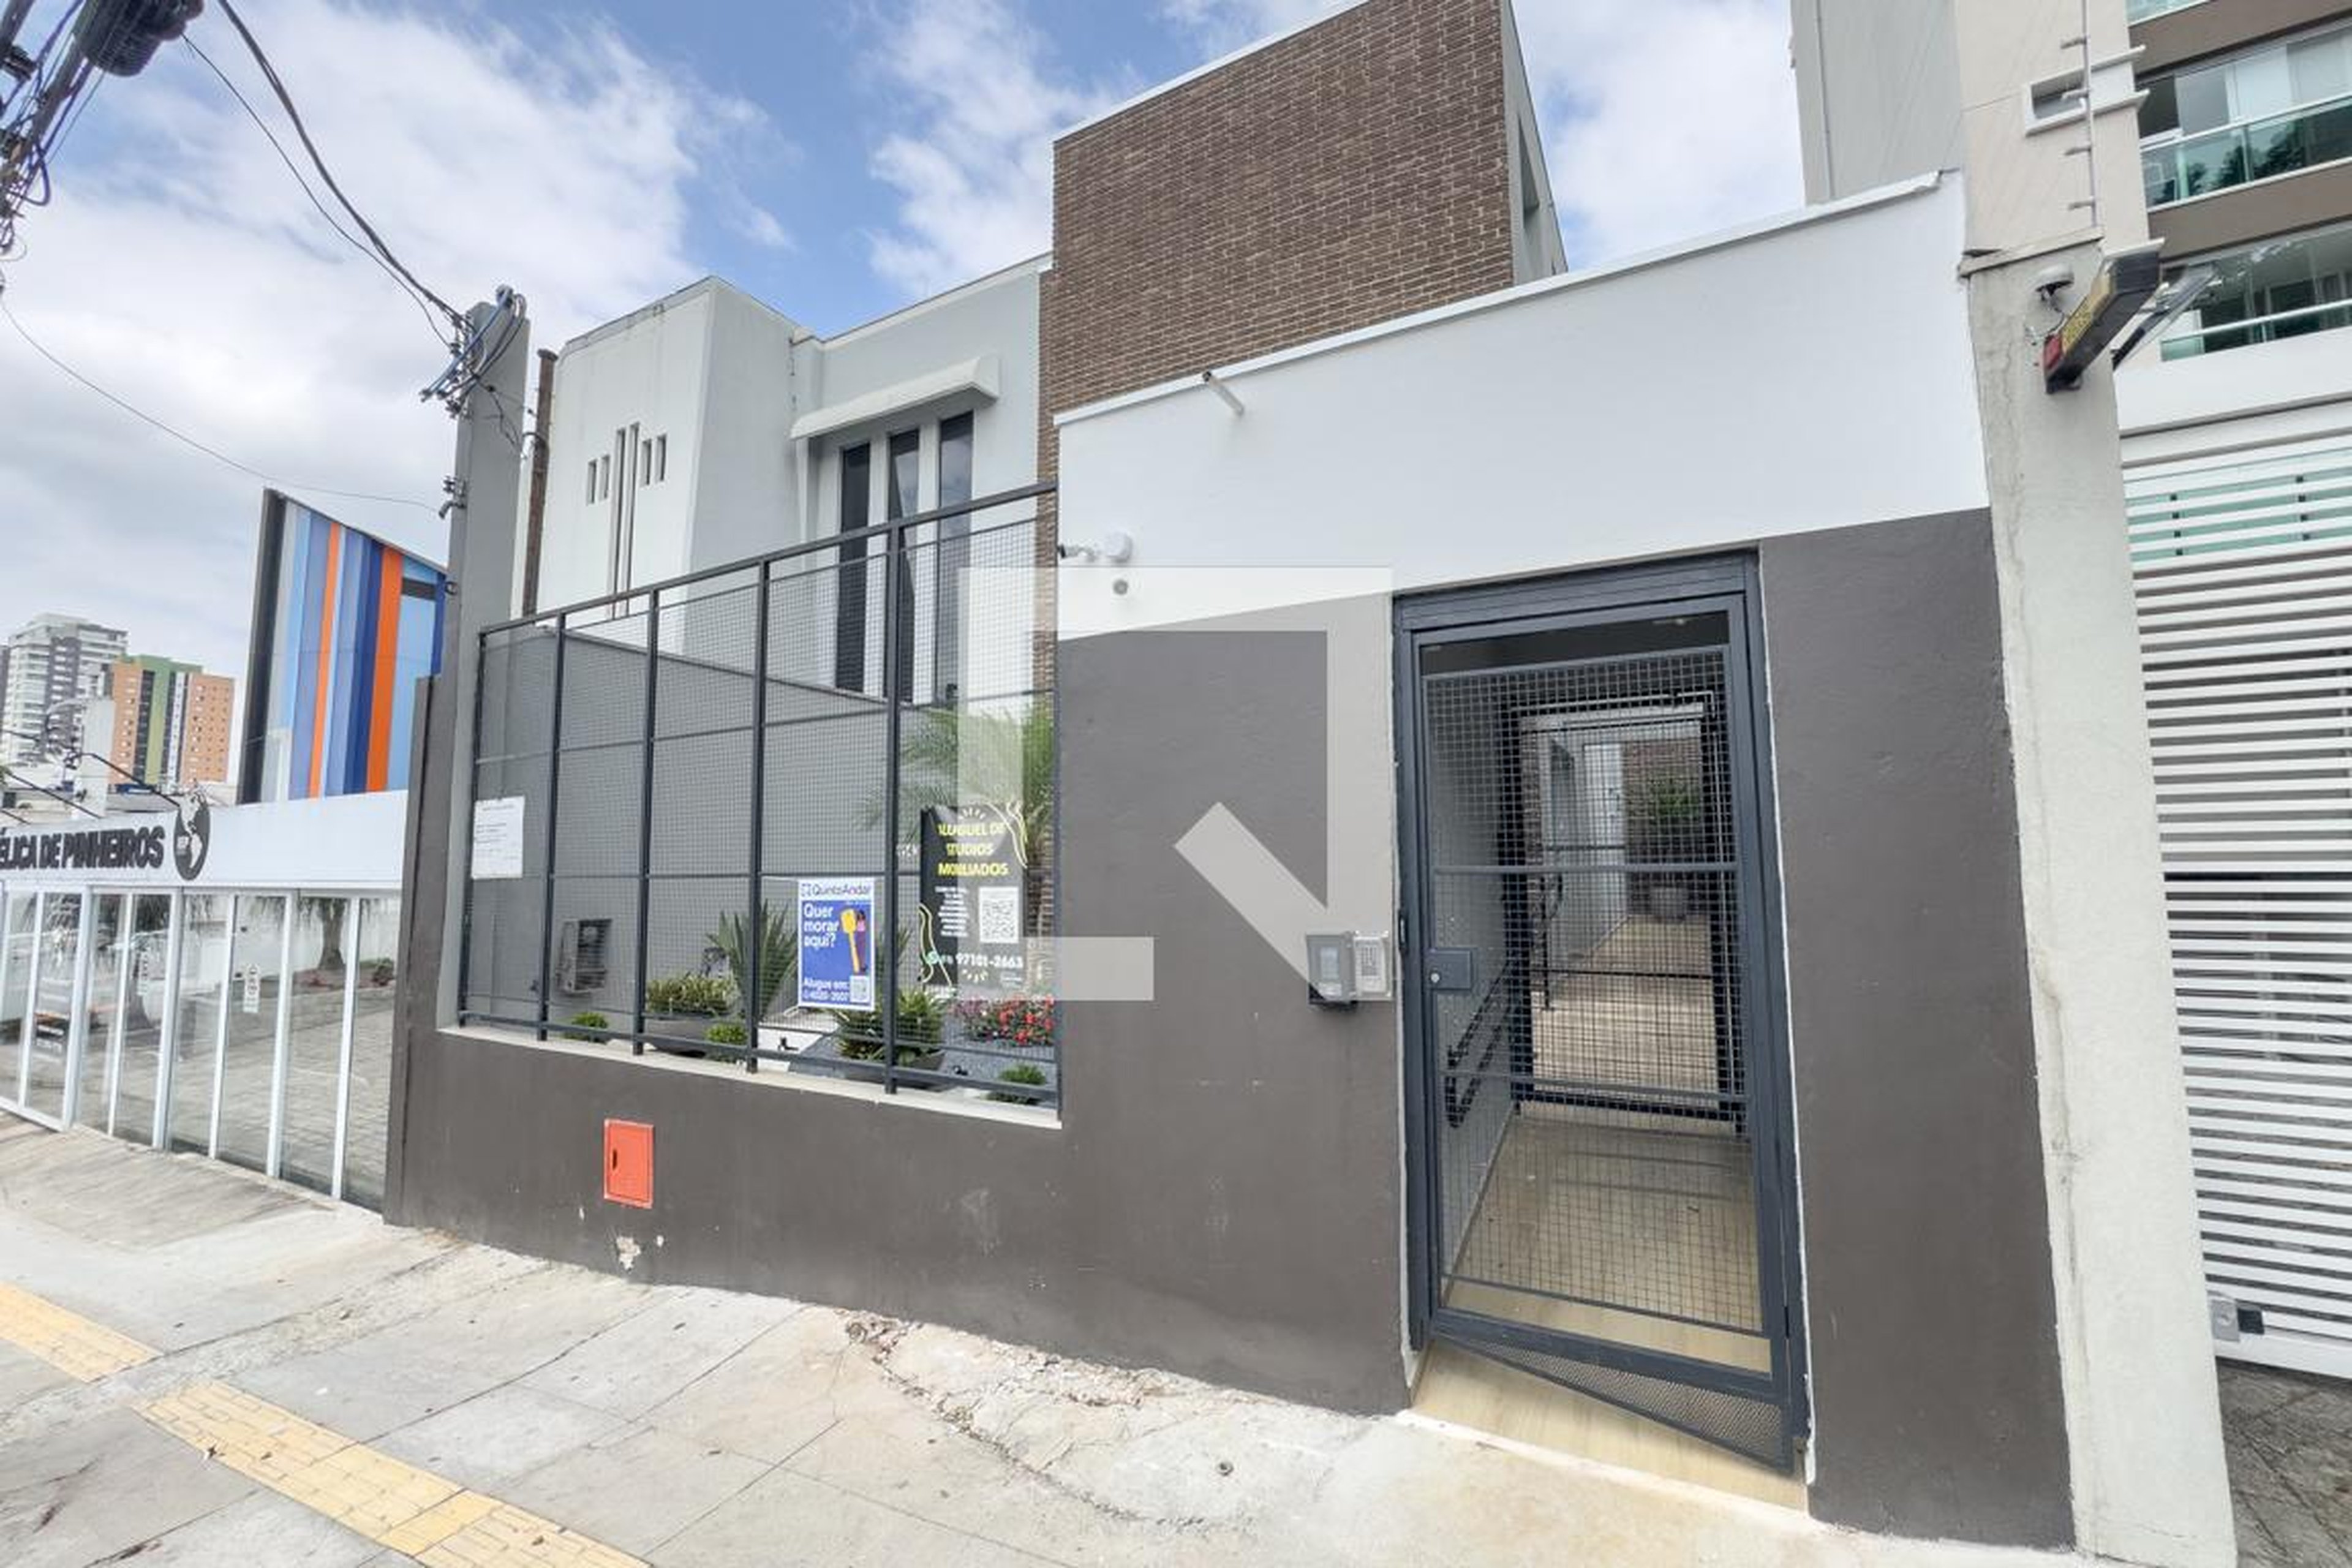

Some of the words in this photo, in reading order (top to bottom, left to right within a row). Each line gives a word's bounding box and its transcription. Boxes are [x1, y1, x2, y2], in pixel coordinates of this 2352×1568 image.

[39, 832, 61, 869] DE
[62, 826, 165, 869] PINHEIROS
[812, 884, 870, 895] QuintoAndar
[804, 903, 834, 918] Quer
[804, 920, 840, 932] morar
[804, 933, 837, 951] aqui?
